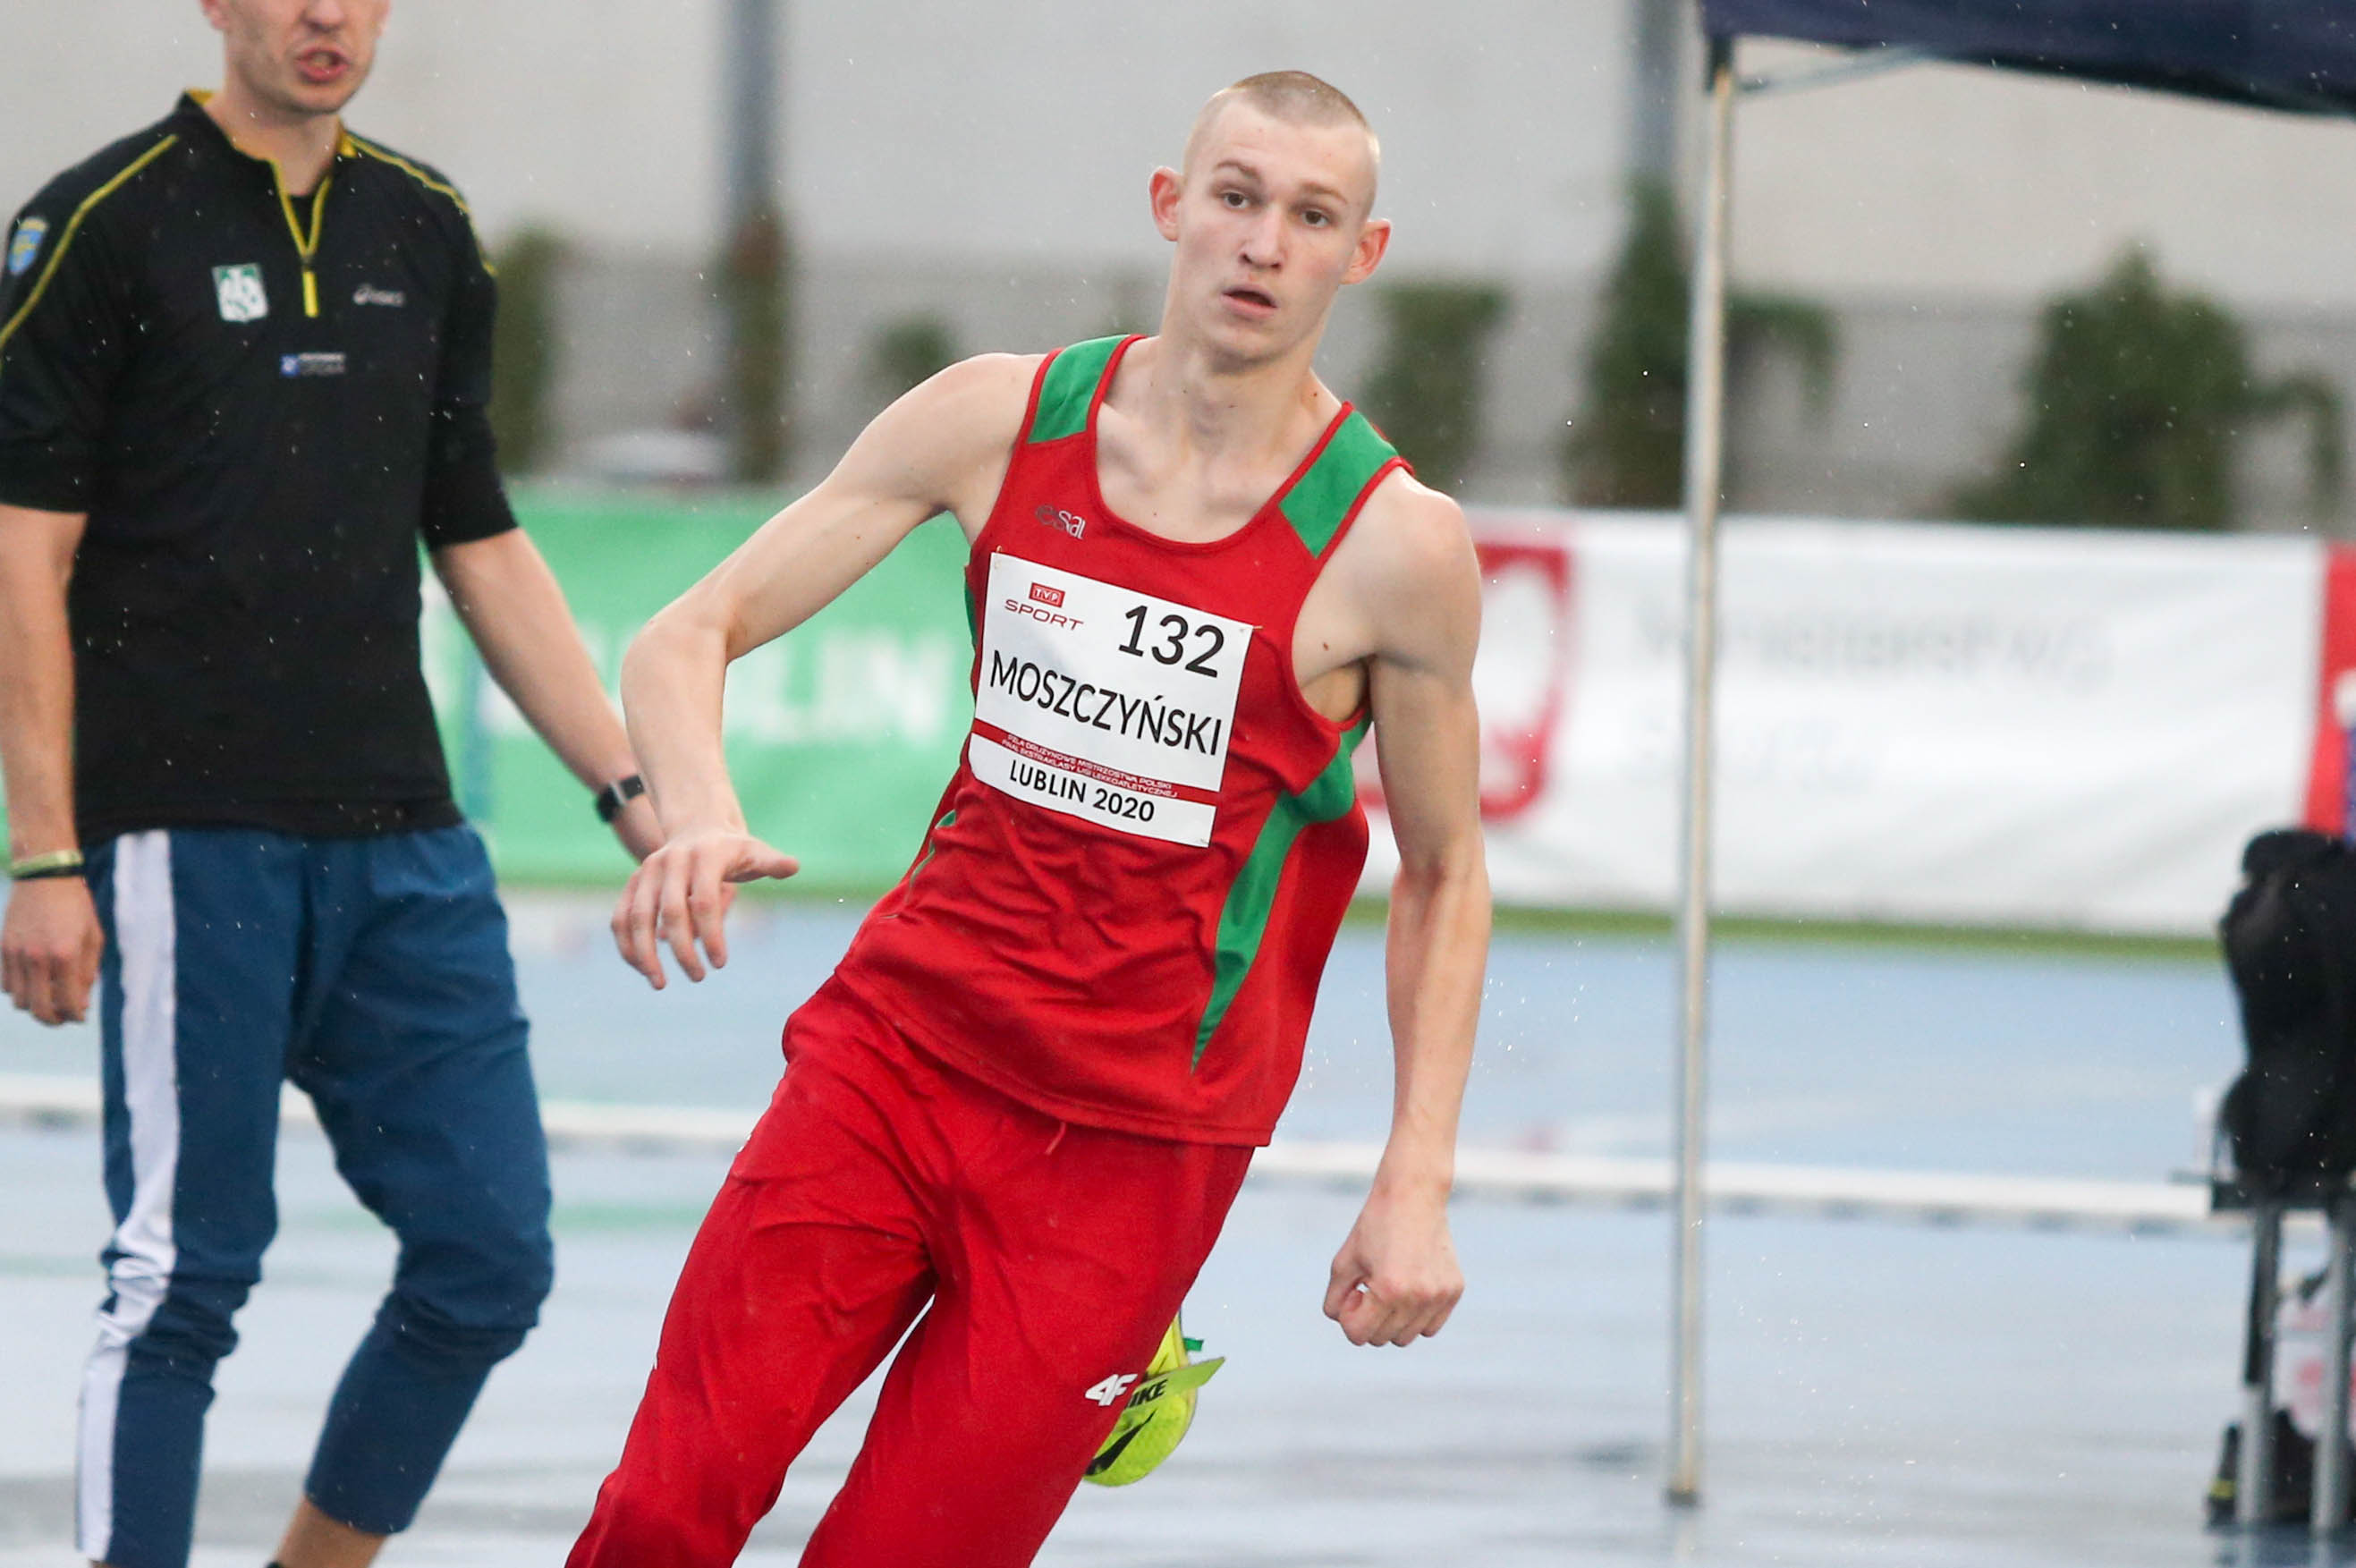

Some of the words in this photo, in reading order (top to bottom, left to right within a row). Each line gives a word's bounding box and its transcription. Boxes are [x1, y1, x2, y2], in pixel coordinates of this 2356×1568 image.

[1035, 587, 1059, 602] TVP
[1004, 598, 1084, 631] SPORT
[1118, 605, 1225, 678] 132
[989, 649, 1223, 756] MOSZCZYŃSKI
[1009, 759, 1086, 803] LUBLIN
[1092, 787, 1155, 822] 2020
[1092, 771, 1178, 798] LEKKOATLETYCZNEJ
[1139, 777, 1172, 790] POLSKI
[1085, 1373, 1138, 1406] 4F
[1126, 1378, 1167, 1408] IKE
